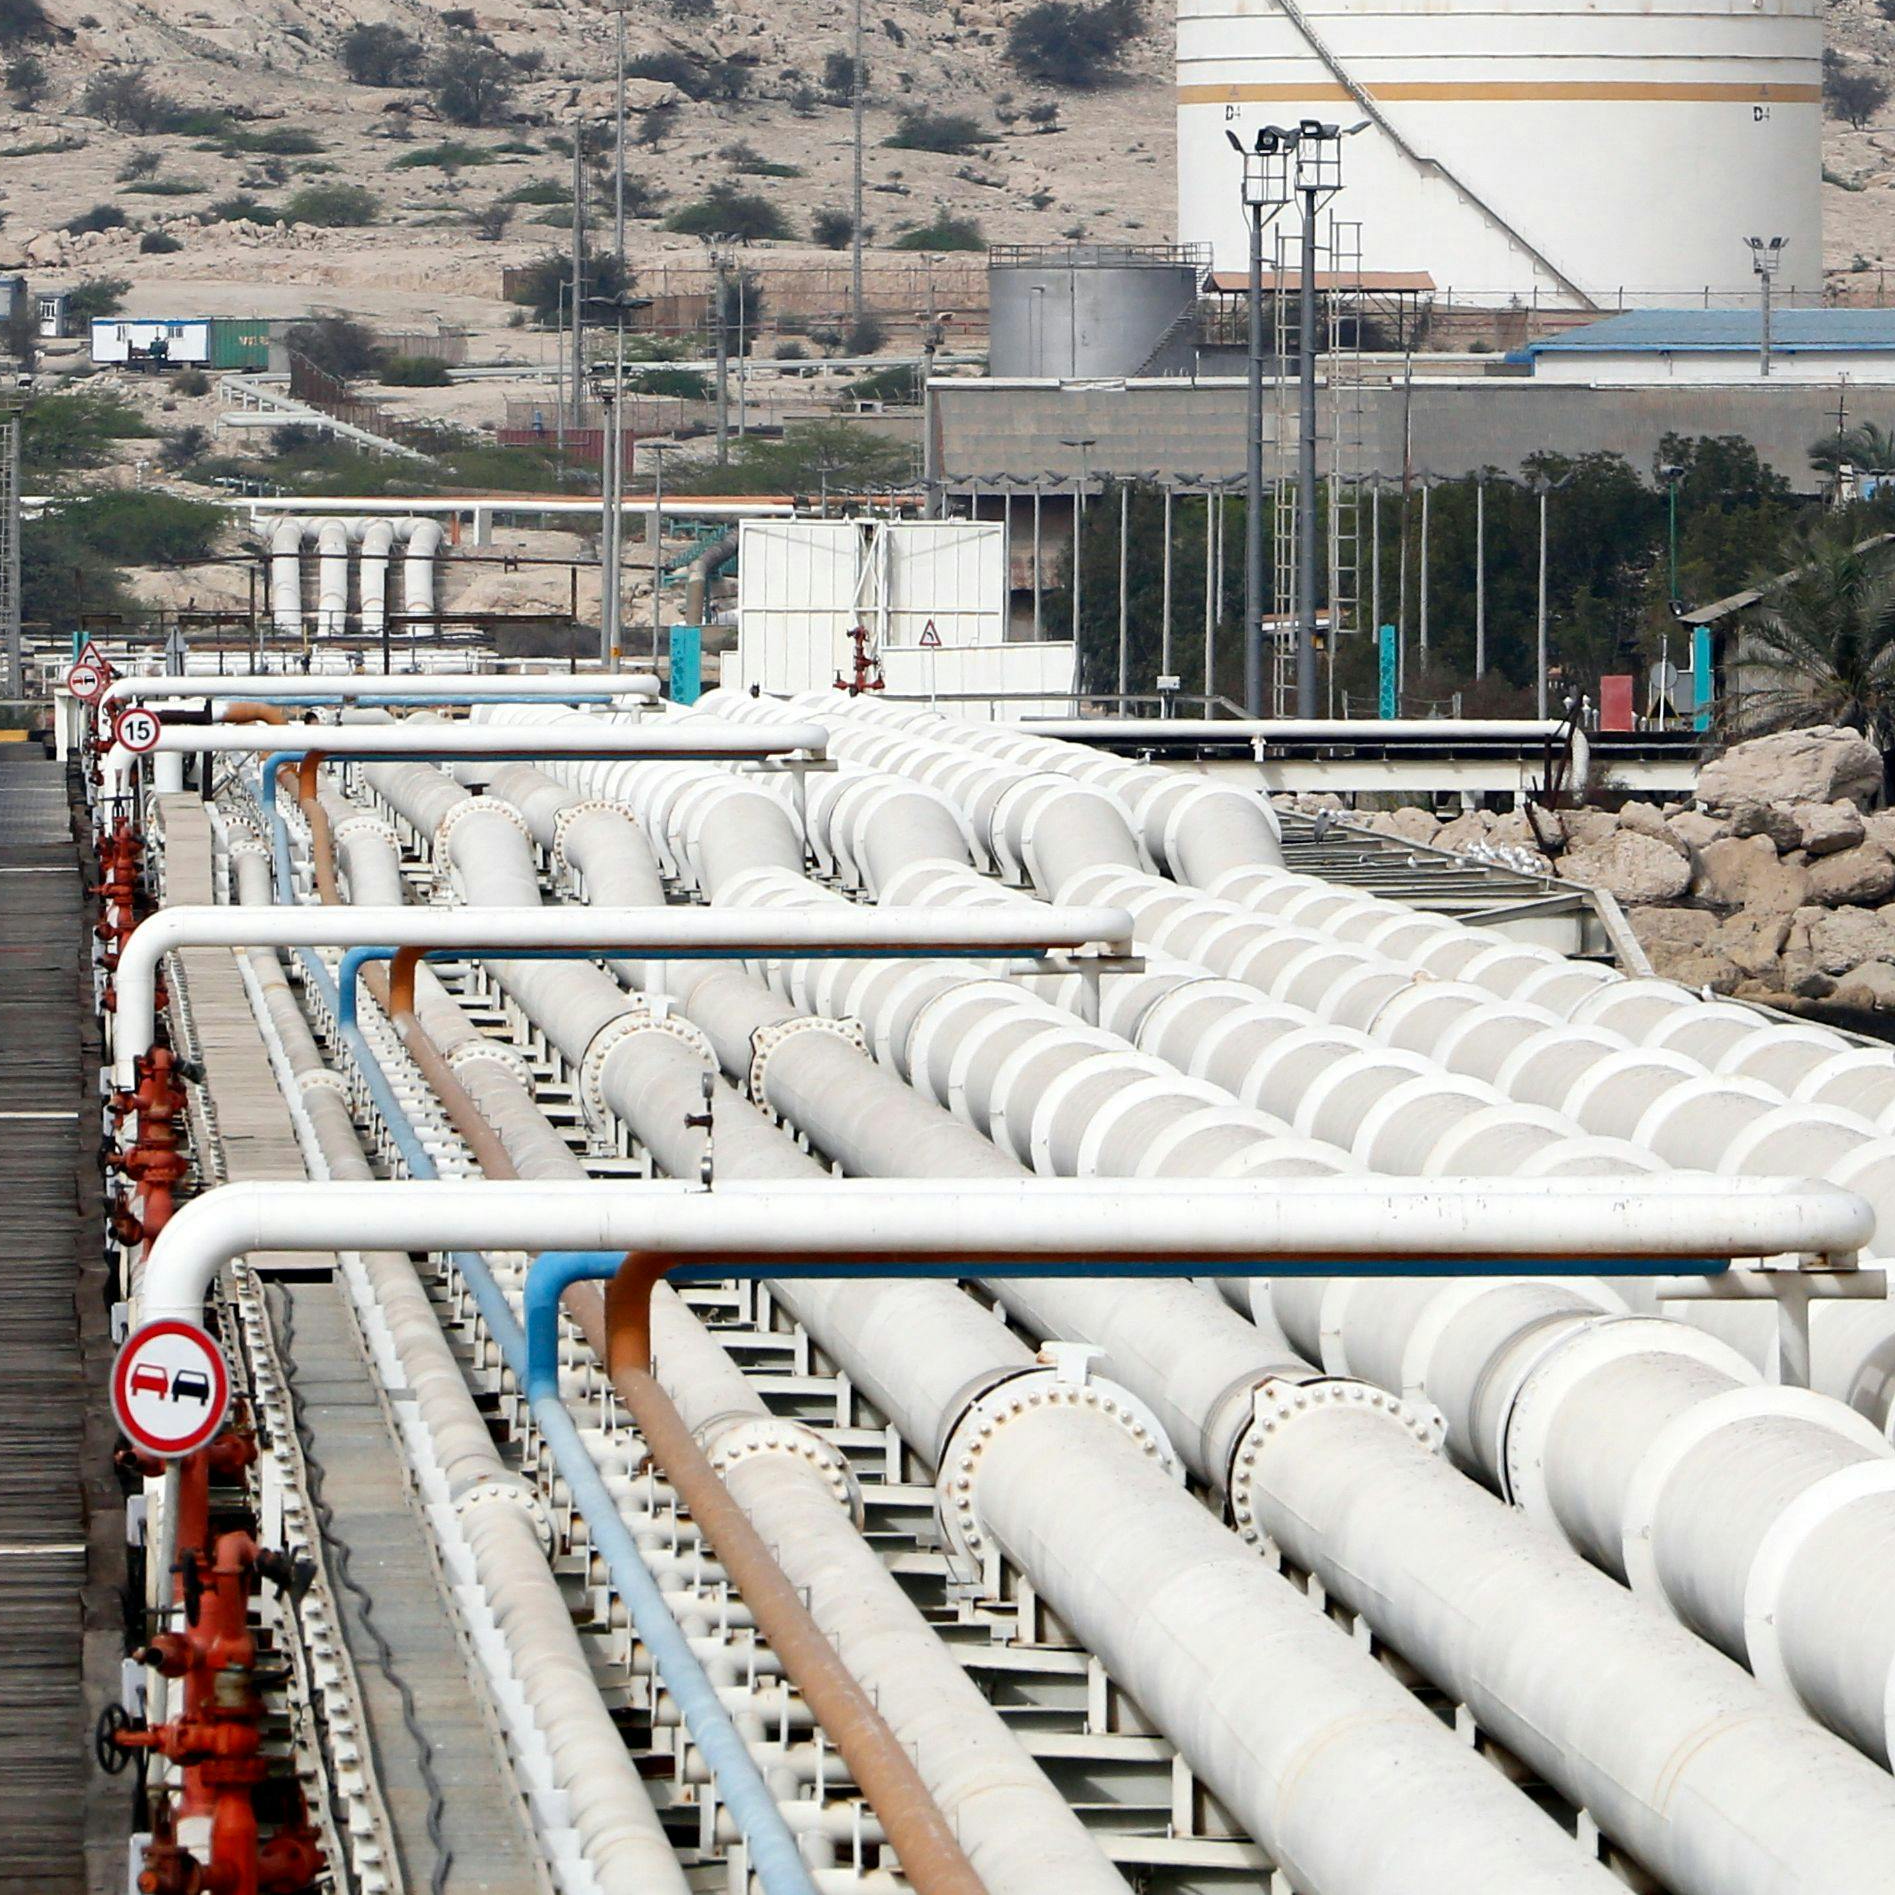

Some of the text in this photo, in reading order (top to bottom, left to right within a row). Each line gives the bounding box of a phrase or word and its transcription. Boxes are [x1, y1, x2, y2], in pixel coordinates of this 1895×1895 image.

[1225, 104, 1241, 121] D4
[1753, 105, 1771, 122] D4
[125, 720, 151, 741] 15
